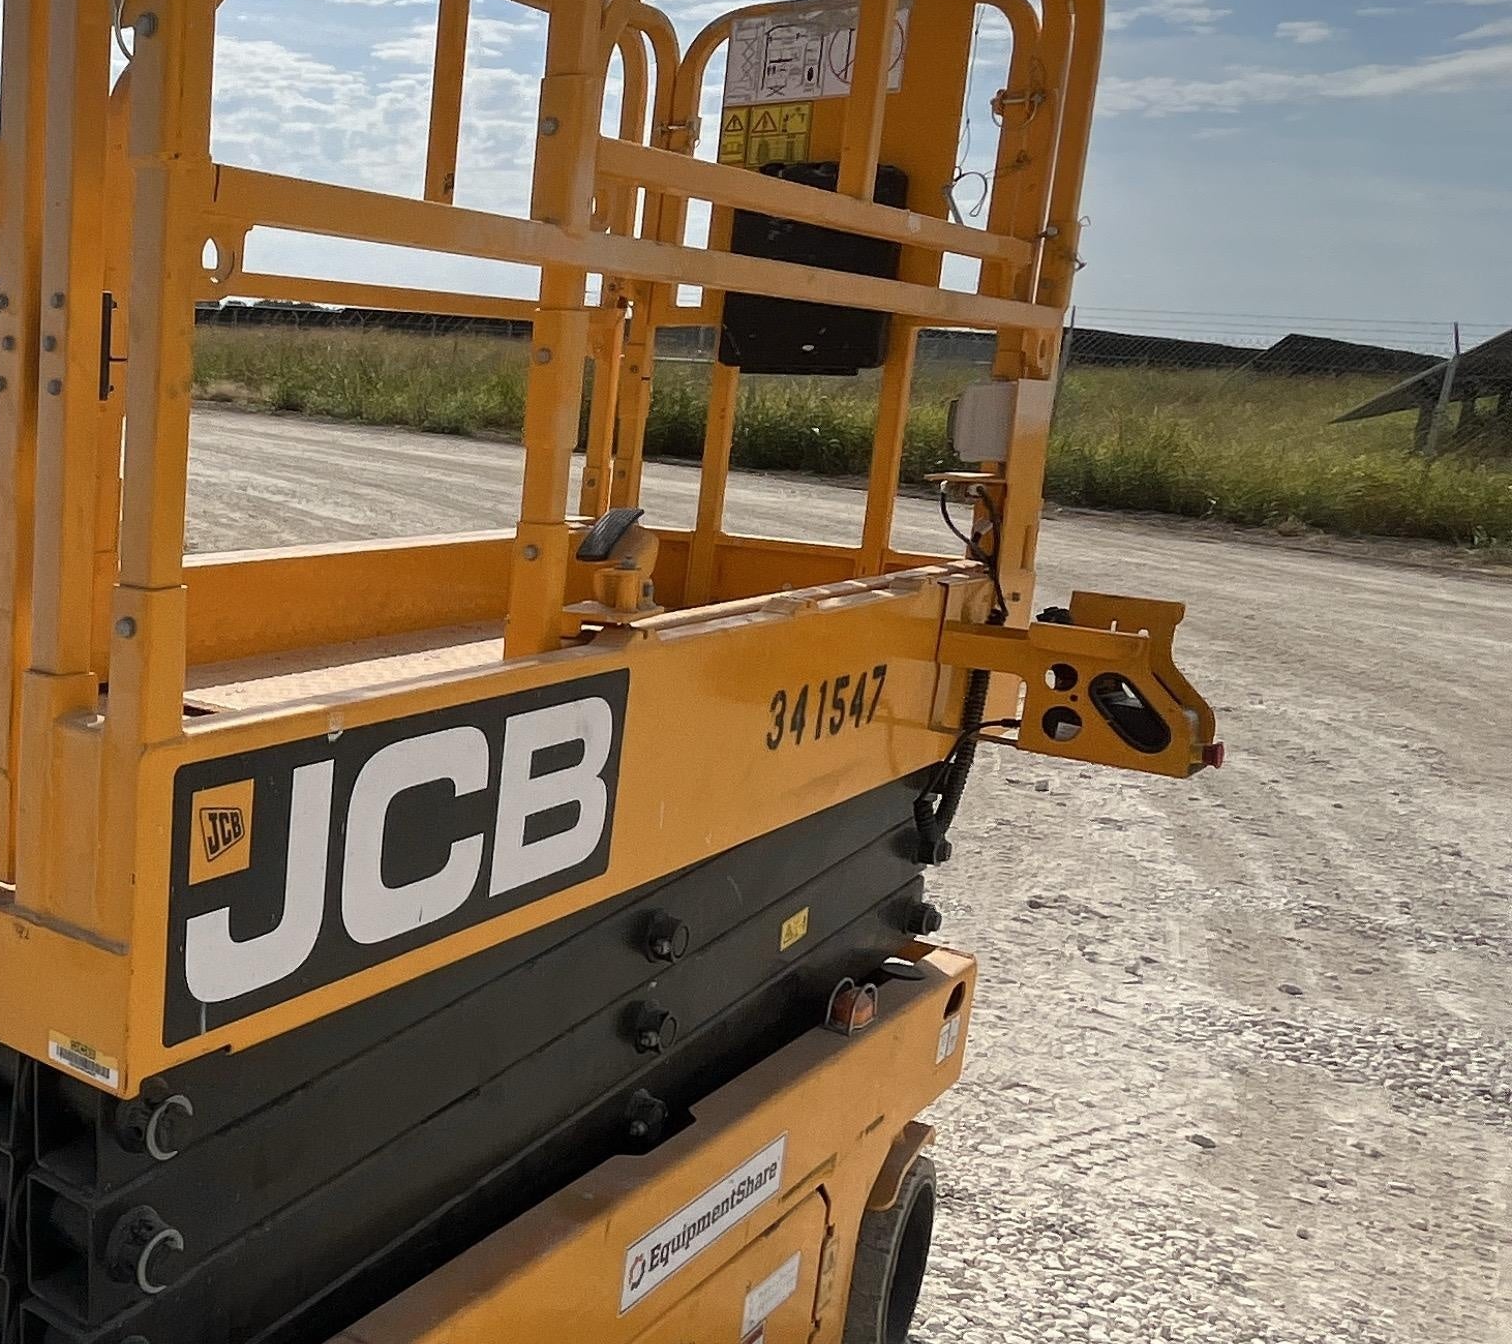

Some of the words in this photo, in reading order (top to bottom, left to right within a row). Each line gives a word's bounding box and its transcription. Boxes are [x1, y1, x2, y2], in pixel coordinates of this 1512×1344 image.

[766, 663, 888, 751] 341547
[184, 695, 614, 1003] JCB
[207, 810, 243, 856] JCB
[647, 1161, 778, 1273] EquipmentShare
